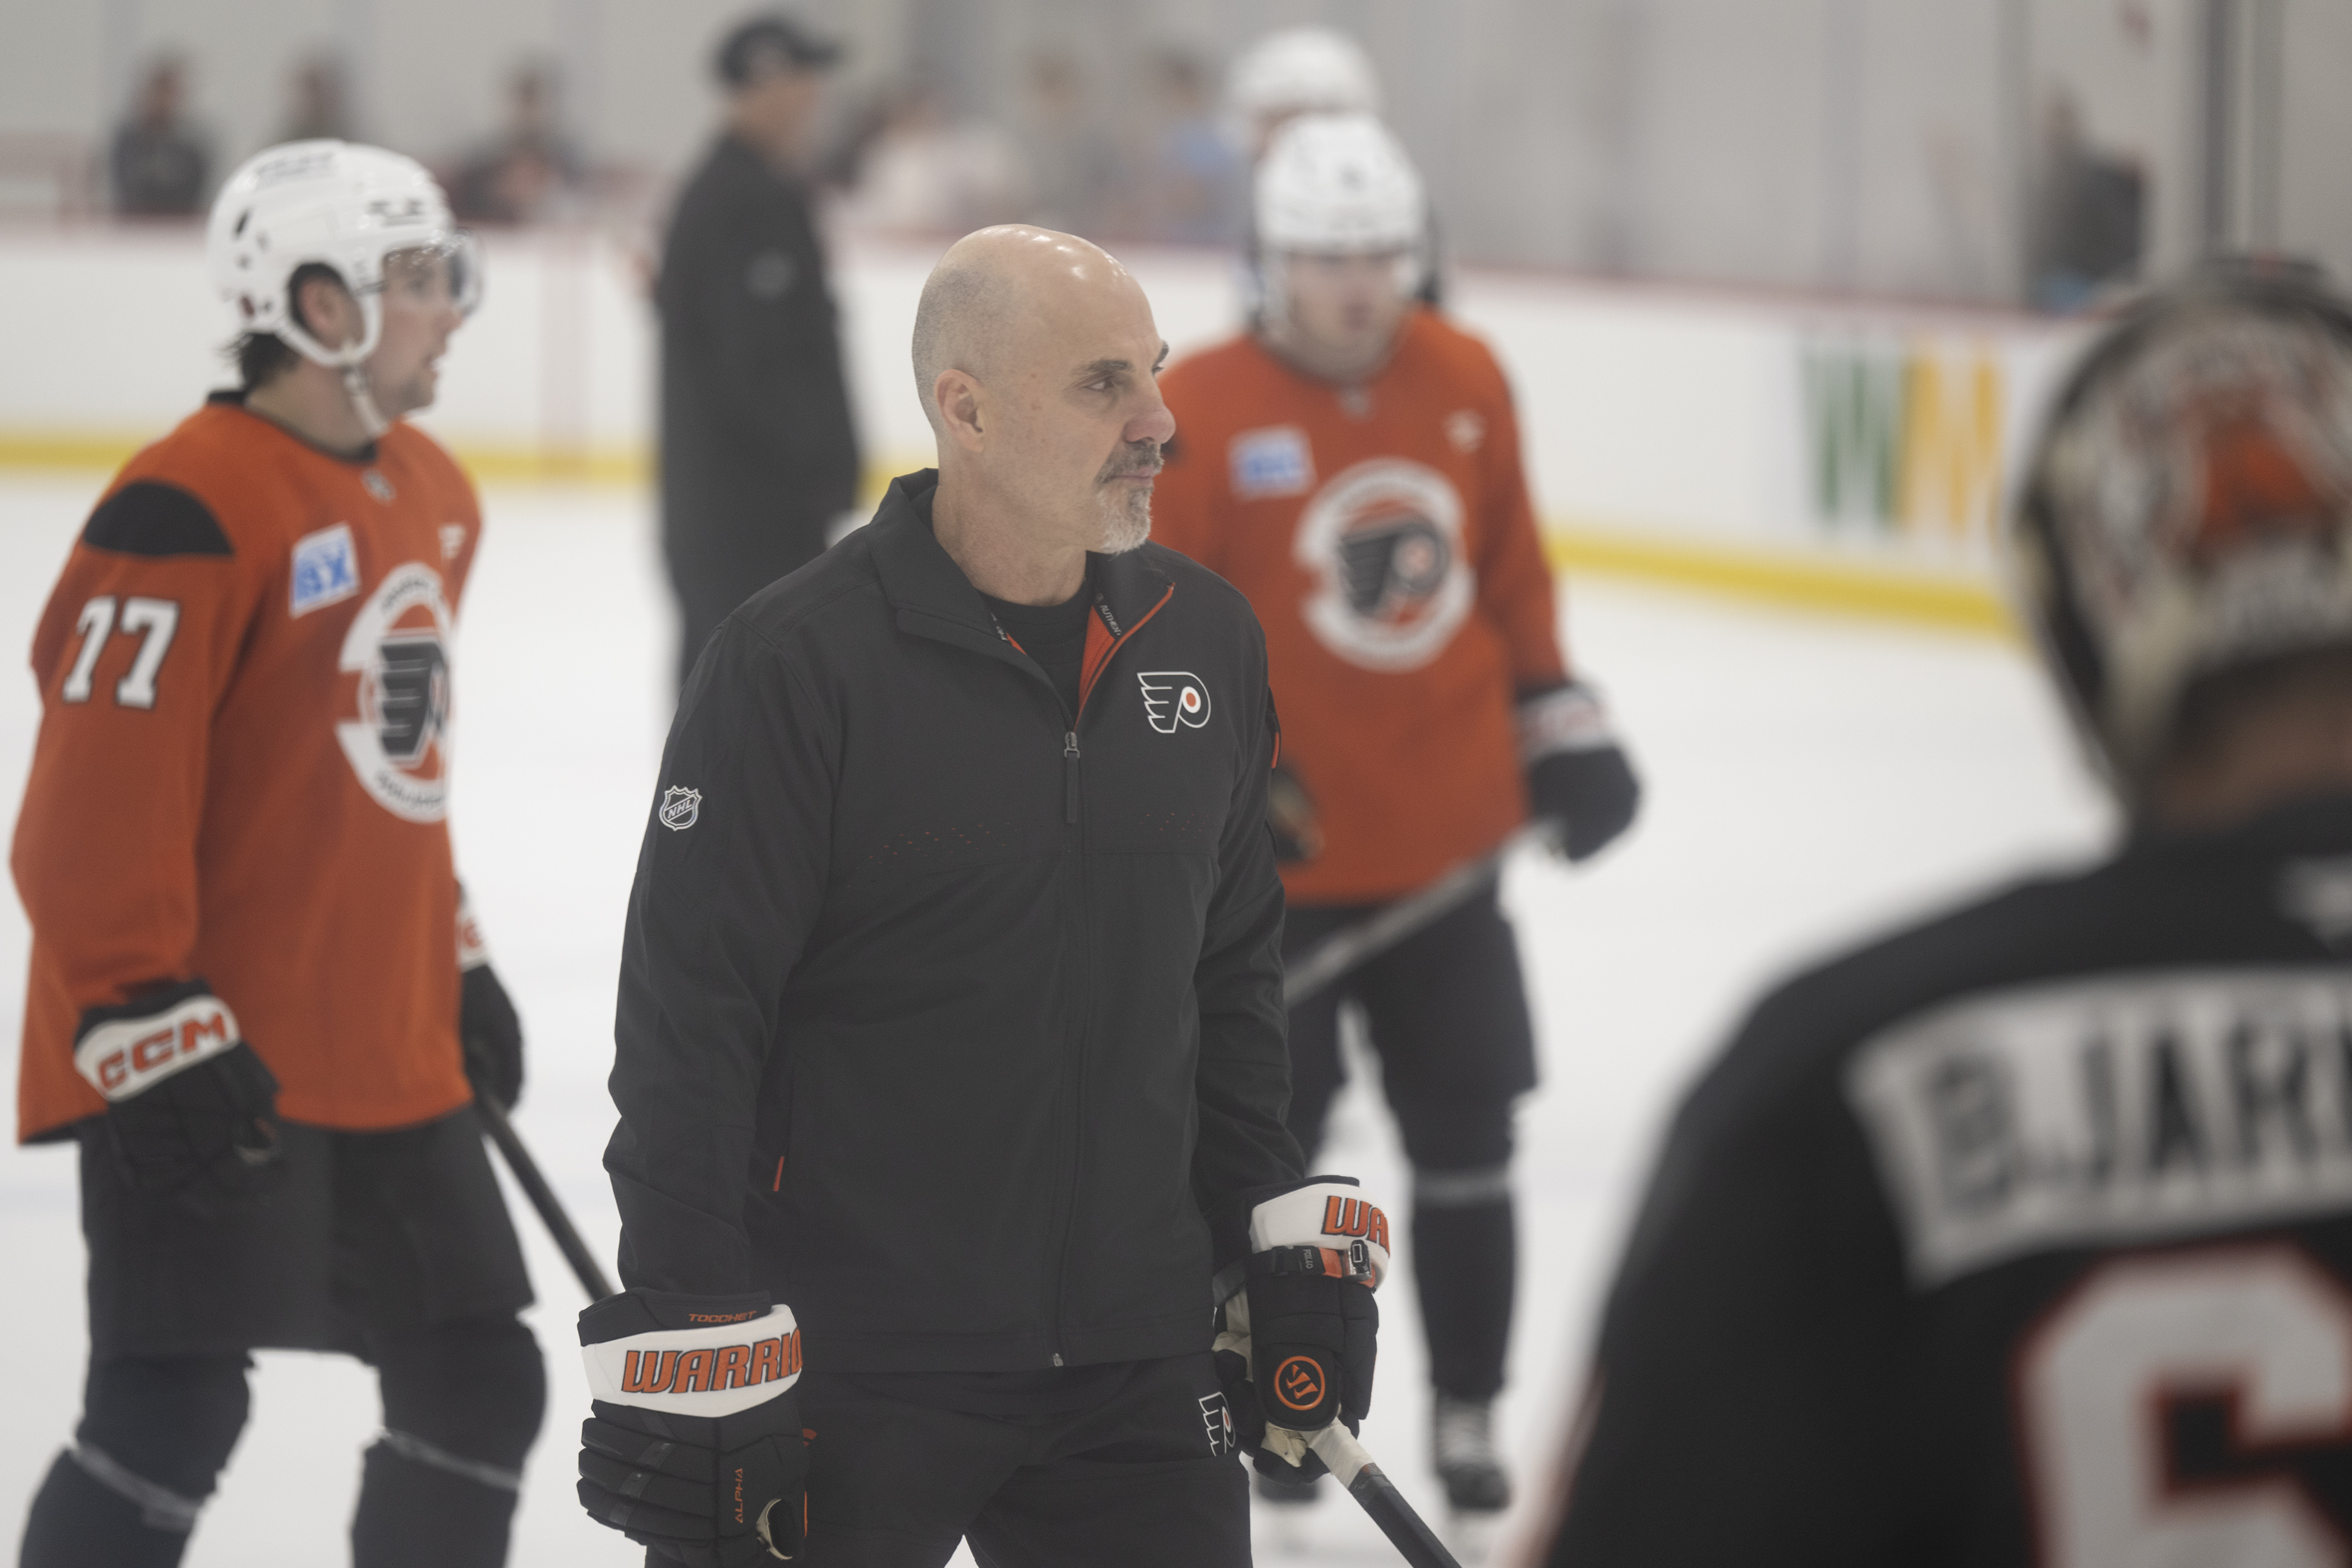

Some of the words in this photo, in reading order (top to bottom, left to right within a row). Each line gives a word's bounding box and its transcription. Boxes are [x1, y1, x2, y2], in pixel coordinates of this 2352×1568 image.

[62, 596, 179, 709] 77
[667, 799, 693, 819] NHL
[97, 1011, 227, 1091] CCM
[735, 1468, 744, 1524] ALPHA
